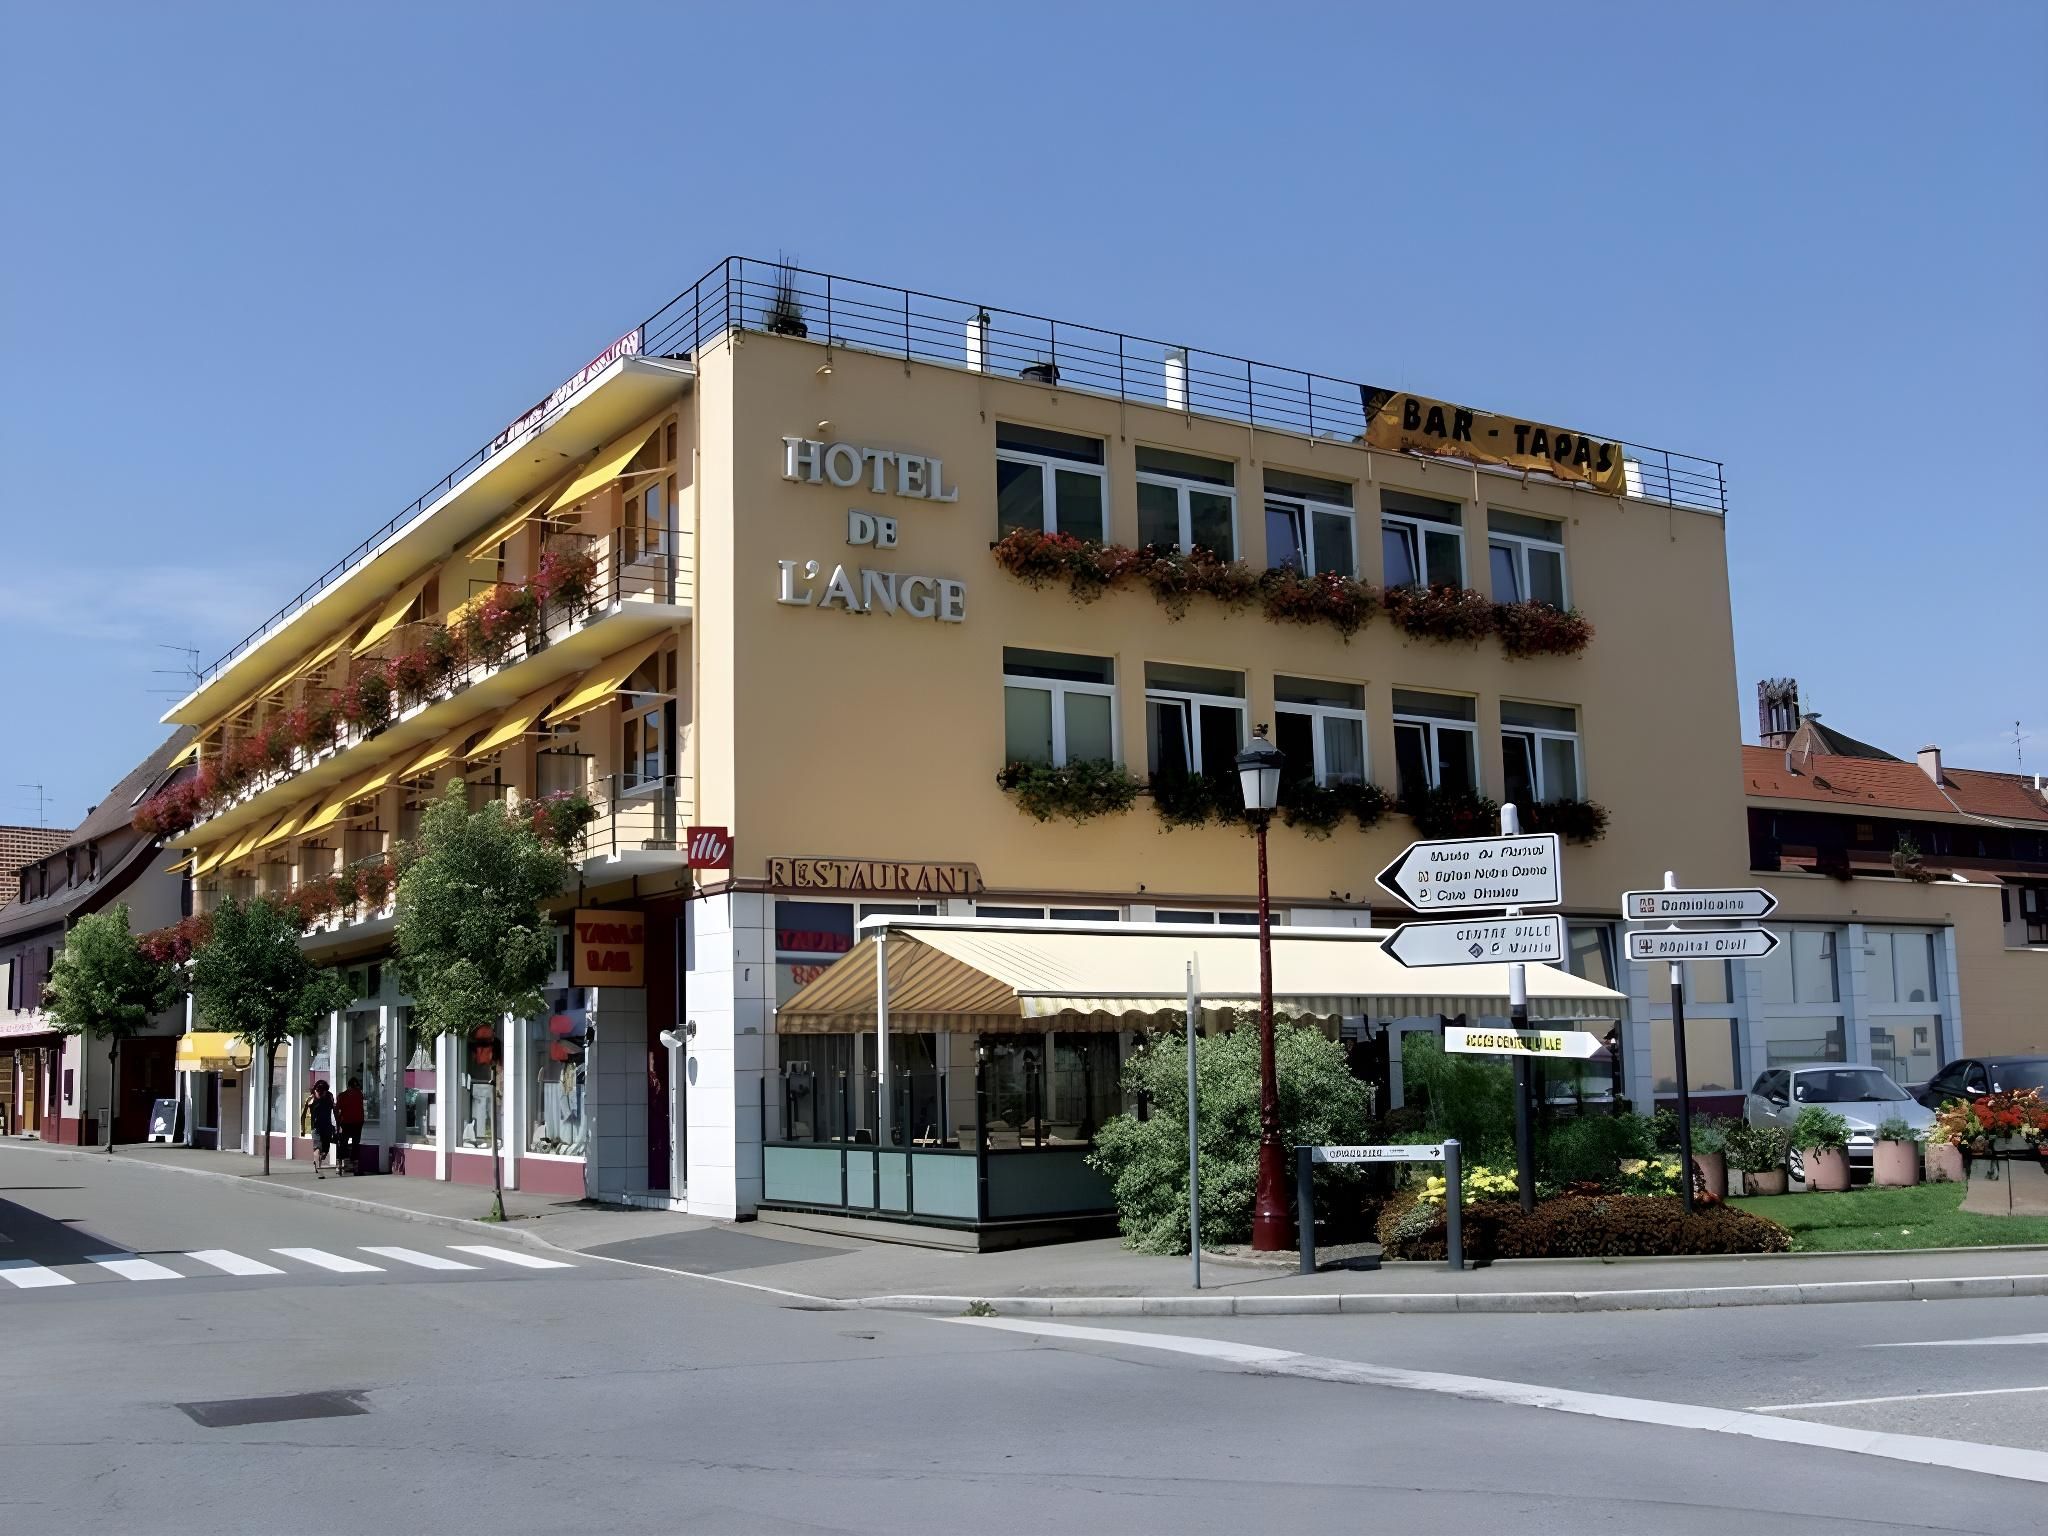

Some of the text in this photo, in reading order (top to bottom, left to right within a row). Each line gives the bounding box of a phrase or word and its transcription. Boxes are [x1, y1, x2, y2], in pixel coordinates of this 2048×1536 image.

[1402, 398, 1474, 442] BAR
[1513, 424, 1613, 473] TAPAS
[781, 436, 959, 503] HOTEL
[846, 508, 898, 550] DE
[776, 559, 968, 624] L'ANGE
[690, 832, 727, 866] illy
[768, 858, 977, 895] RESTAURANT
